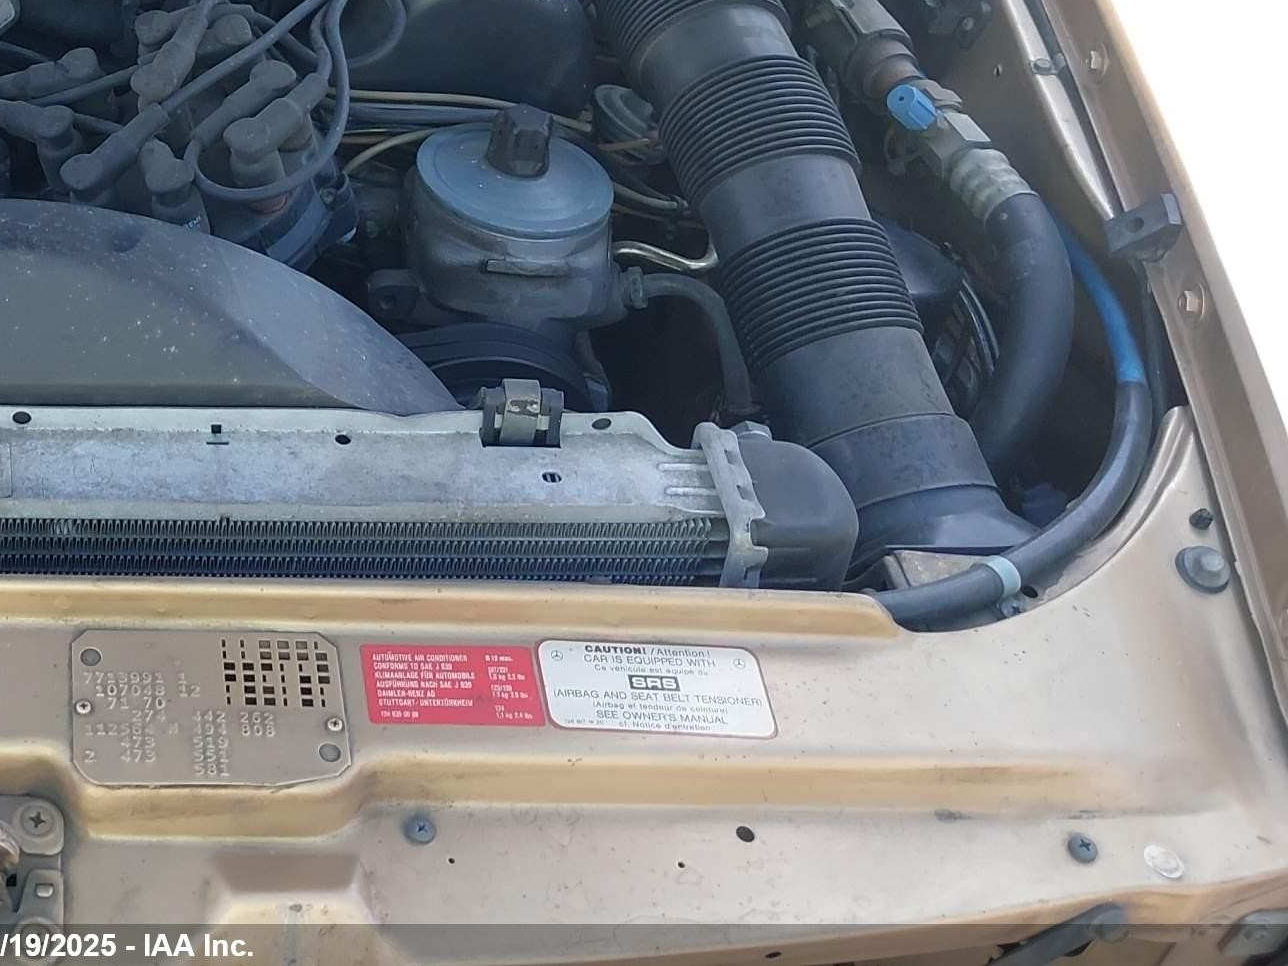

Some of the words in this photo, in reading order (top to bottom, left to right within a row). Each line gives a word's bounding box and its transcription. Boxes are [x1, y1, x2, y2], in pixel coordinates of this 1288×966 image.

[584, 644, 647, 655] CAUTION!
[372, 653, 412, 662] AUTOMOTIVE
[426, 654, 468, 662] CONDITIONER
[583, 654, 608, 663] CAR
[611, 655, 623, 664] IS
[626, 655, 683, 666] EQUIPPED
[686, 658, 716, 667] WITH
[373, 662, 409, 670] CONFORMS
[374, 671, 419, 679] KLIMAANLAGE
[631, 676, 678, 690] SRS
[95, 684, 166, 697] 107048
[178, 684, 201, 698] 12
[377, 689, 425, 697] DAIMLER-BENZ
[107, 696, 130, 709] 71
[143, 696, 166, 709] 70
[553, 689, 600, 699] (AIRBAG
[603, 690, 628, 700] AND
[631, 692, 660, 701] SEAT
[662, 693, 690, 703] BELT
[694, 694, 763, 707] TENSIONER)
[239, 711, 275, 725] 262
[595, 709, 620, 719] SEE
[622, 711, 677, 723] OWNER'S
[679, 714, 729, 725] MANUAL
[241, 724, 276, 737] 808
[632, 721, 662, 729] Notice
[83, 749, 97, 763] 2
[193, 761, 230, 777] 581
